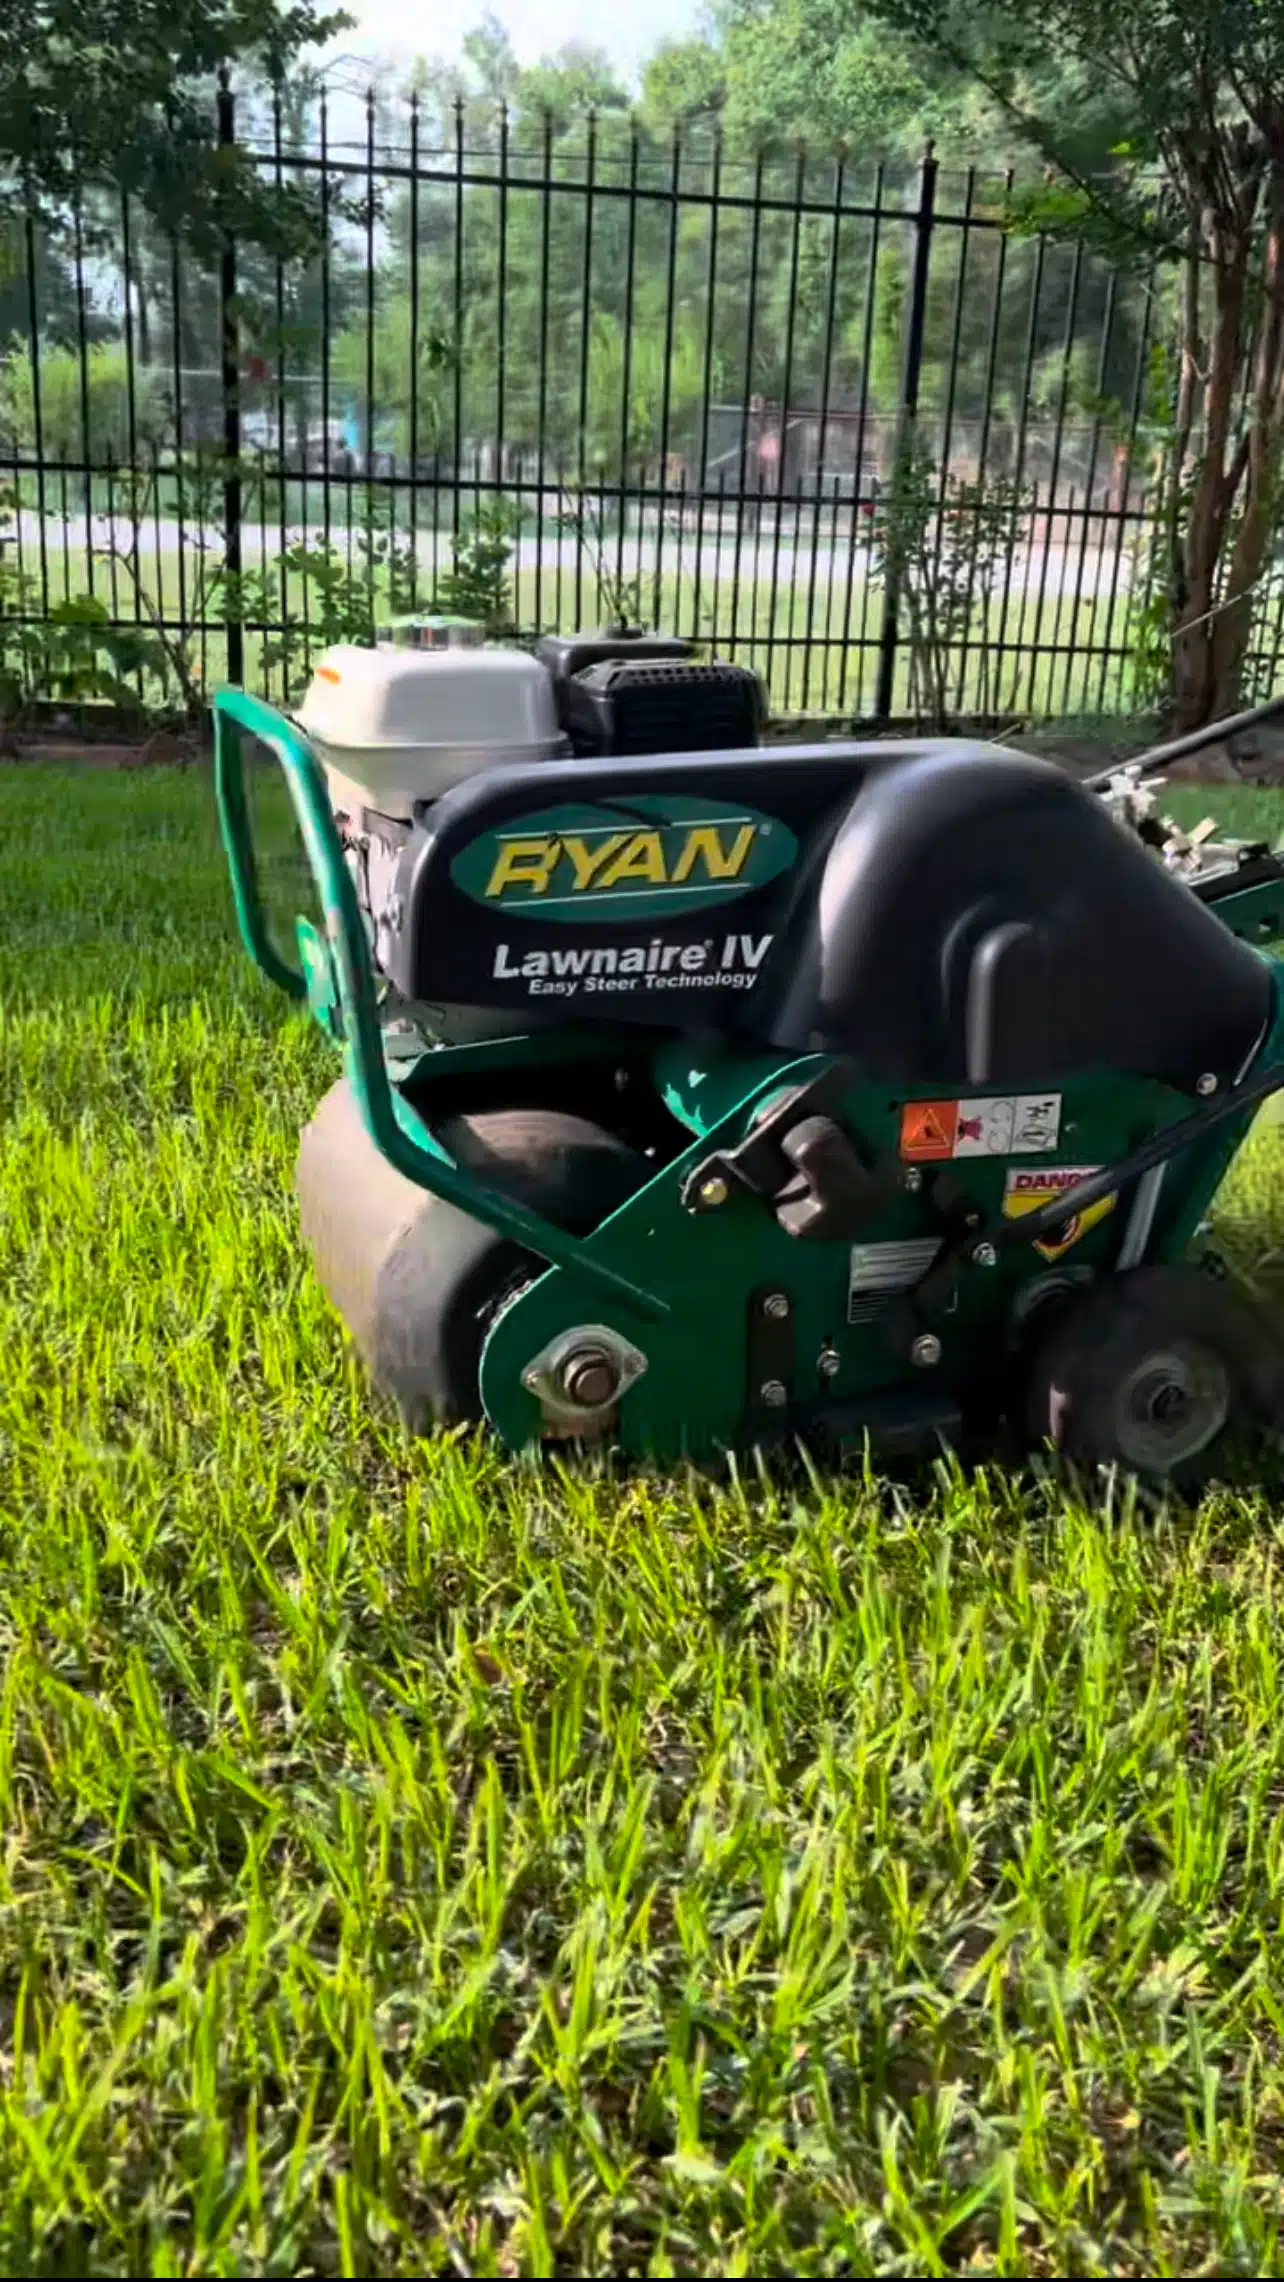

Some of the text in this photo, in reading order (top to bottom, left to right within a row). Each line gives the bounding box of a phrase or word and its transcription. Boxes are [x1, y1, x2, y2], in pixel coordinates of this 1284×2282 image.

[484, 824, 757, 898] RYAN
[492, 934, 775, 978] Lawnaire IV
[528, 971, 758, 997] Easy Steer Technology
